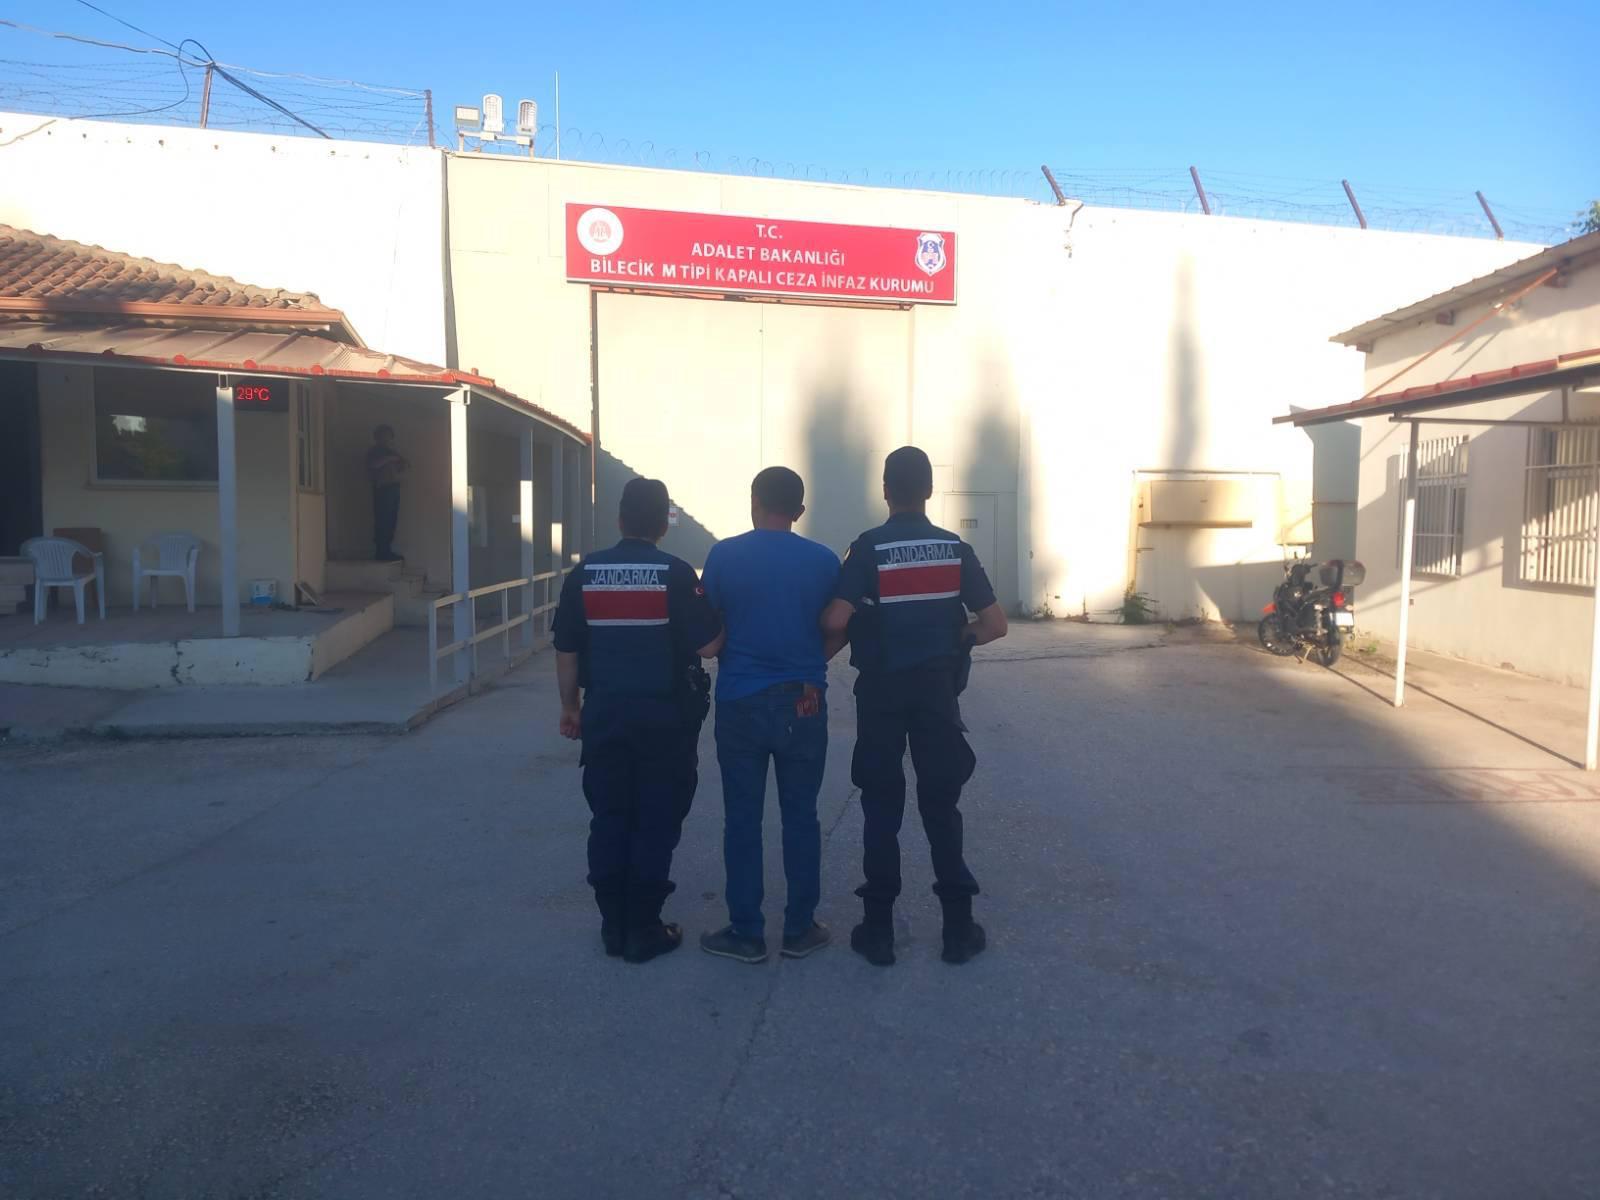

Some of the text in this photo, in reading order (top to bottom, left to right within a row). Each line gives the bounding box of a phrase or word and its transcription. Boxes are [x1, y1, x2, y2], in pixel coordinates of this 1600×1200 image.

[756, 223, 783, 239] T.C.
[691, 242, 845, 266] ADALET BAKANLIĞI
[590, 256, 934, 294] BİLECİK M TİPİ KAPALI CEZA İNFAZ KURUMU
[886, 543, 955, 564] JANDARMA
[591, 569, 659, 585] JANDARMA
